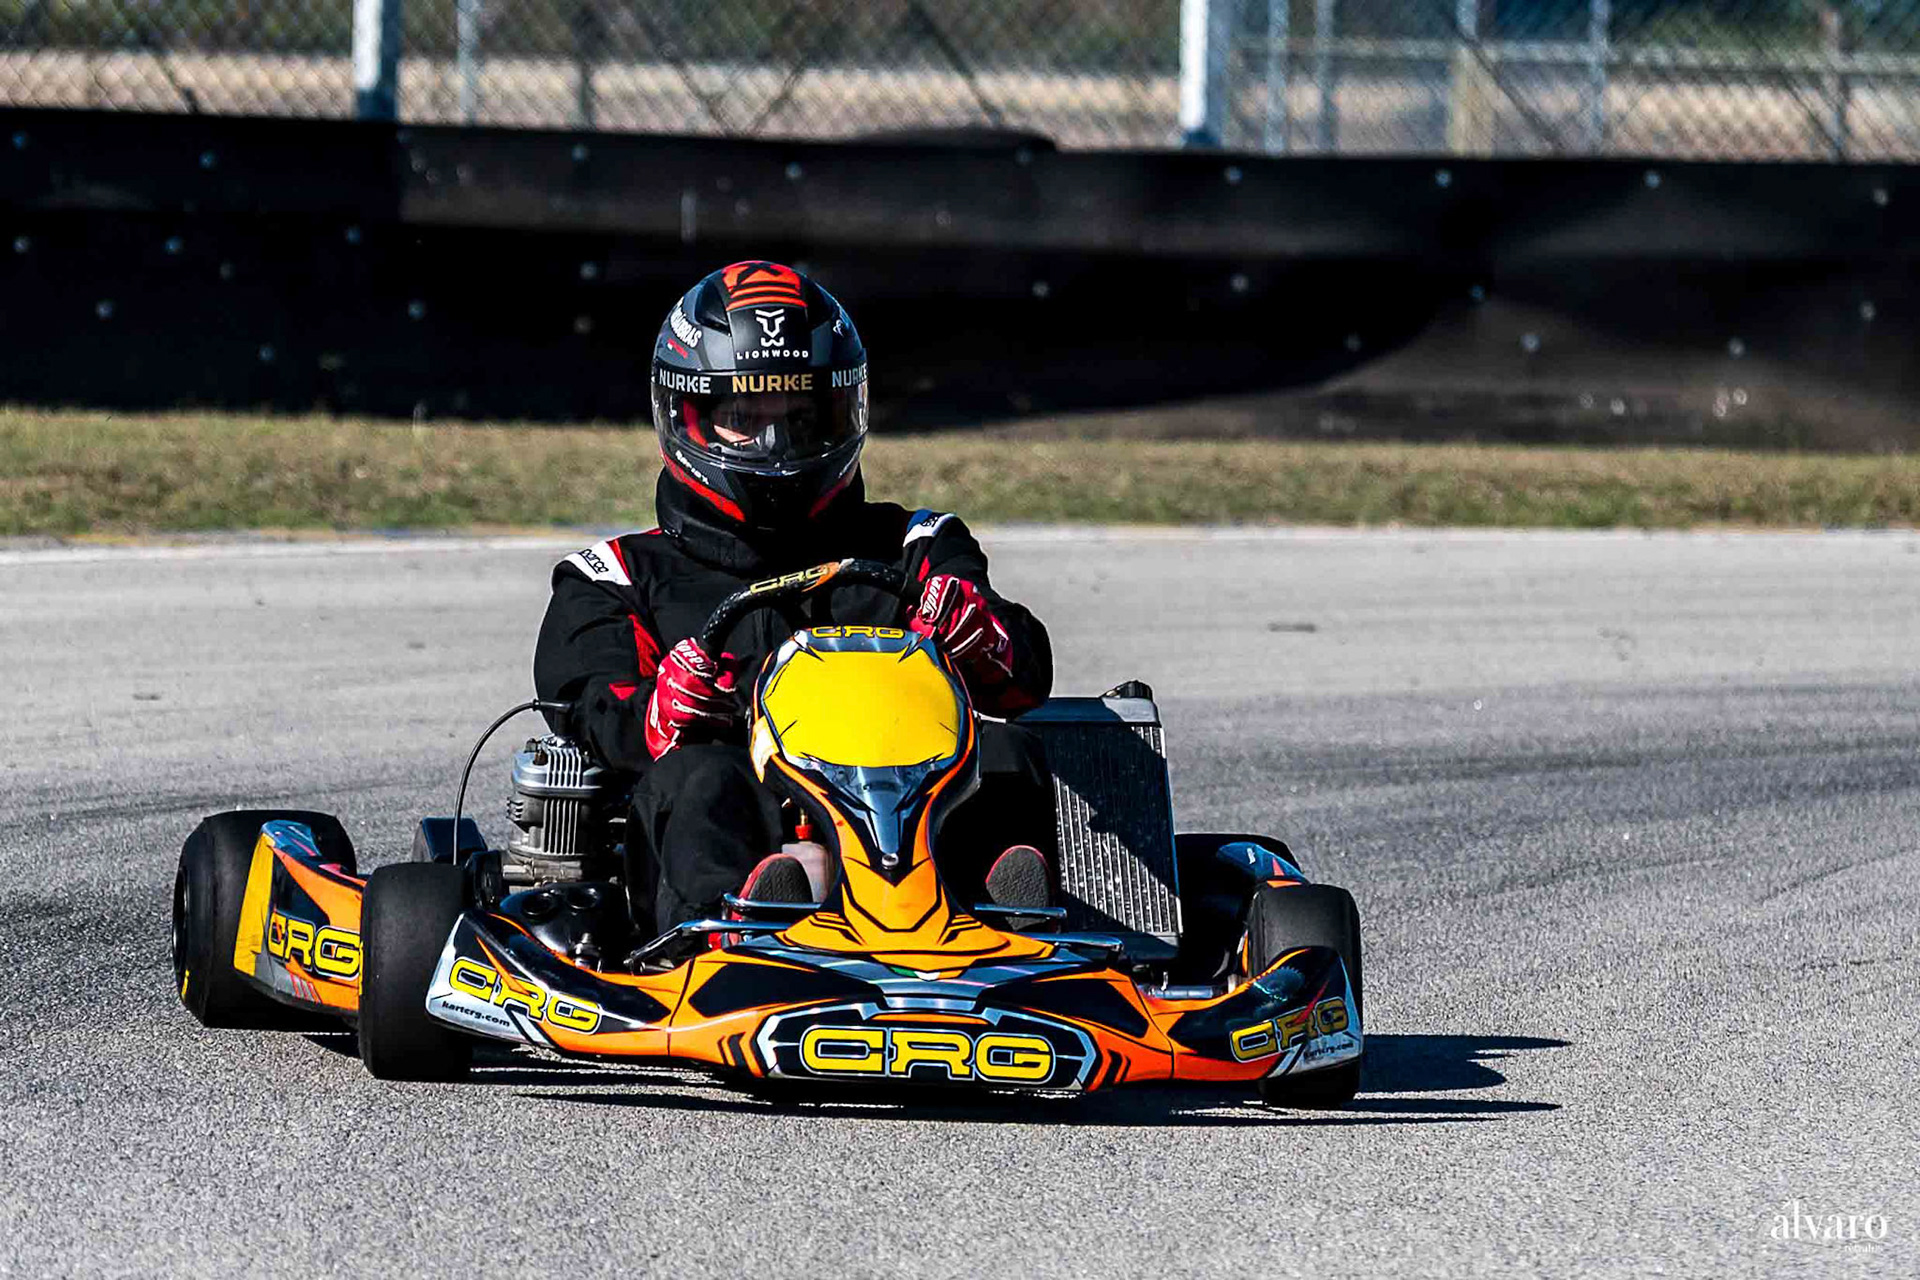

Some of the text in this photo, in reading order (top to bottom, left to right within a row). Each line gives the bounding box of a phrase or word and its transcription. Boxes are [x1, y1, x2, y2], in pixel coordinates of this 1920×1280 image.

[736, 349, 809, 360] LIONWOOD
[658, 368, 712, 395] NURKE
[732, 373, 814, 393] NURKE
[578, 548, 609, 574] parco
[750, 564, 830, 594] CRG
[811, 625, 905, 639] CRG
[267, 910, 363, 979] CRG
[448, 956, 603, 1035] CRG
[442, 1000, 510, 1028] kartcrg.com
[1230, 998, 1349, 1063] CRG
[801, 1026, 1054, 1083] CRG
